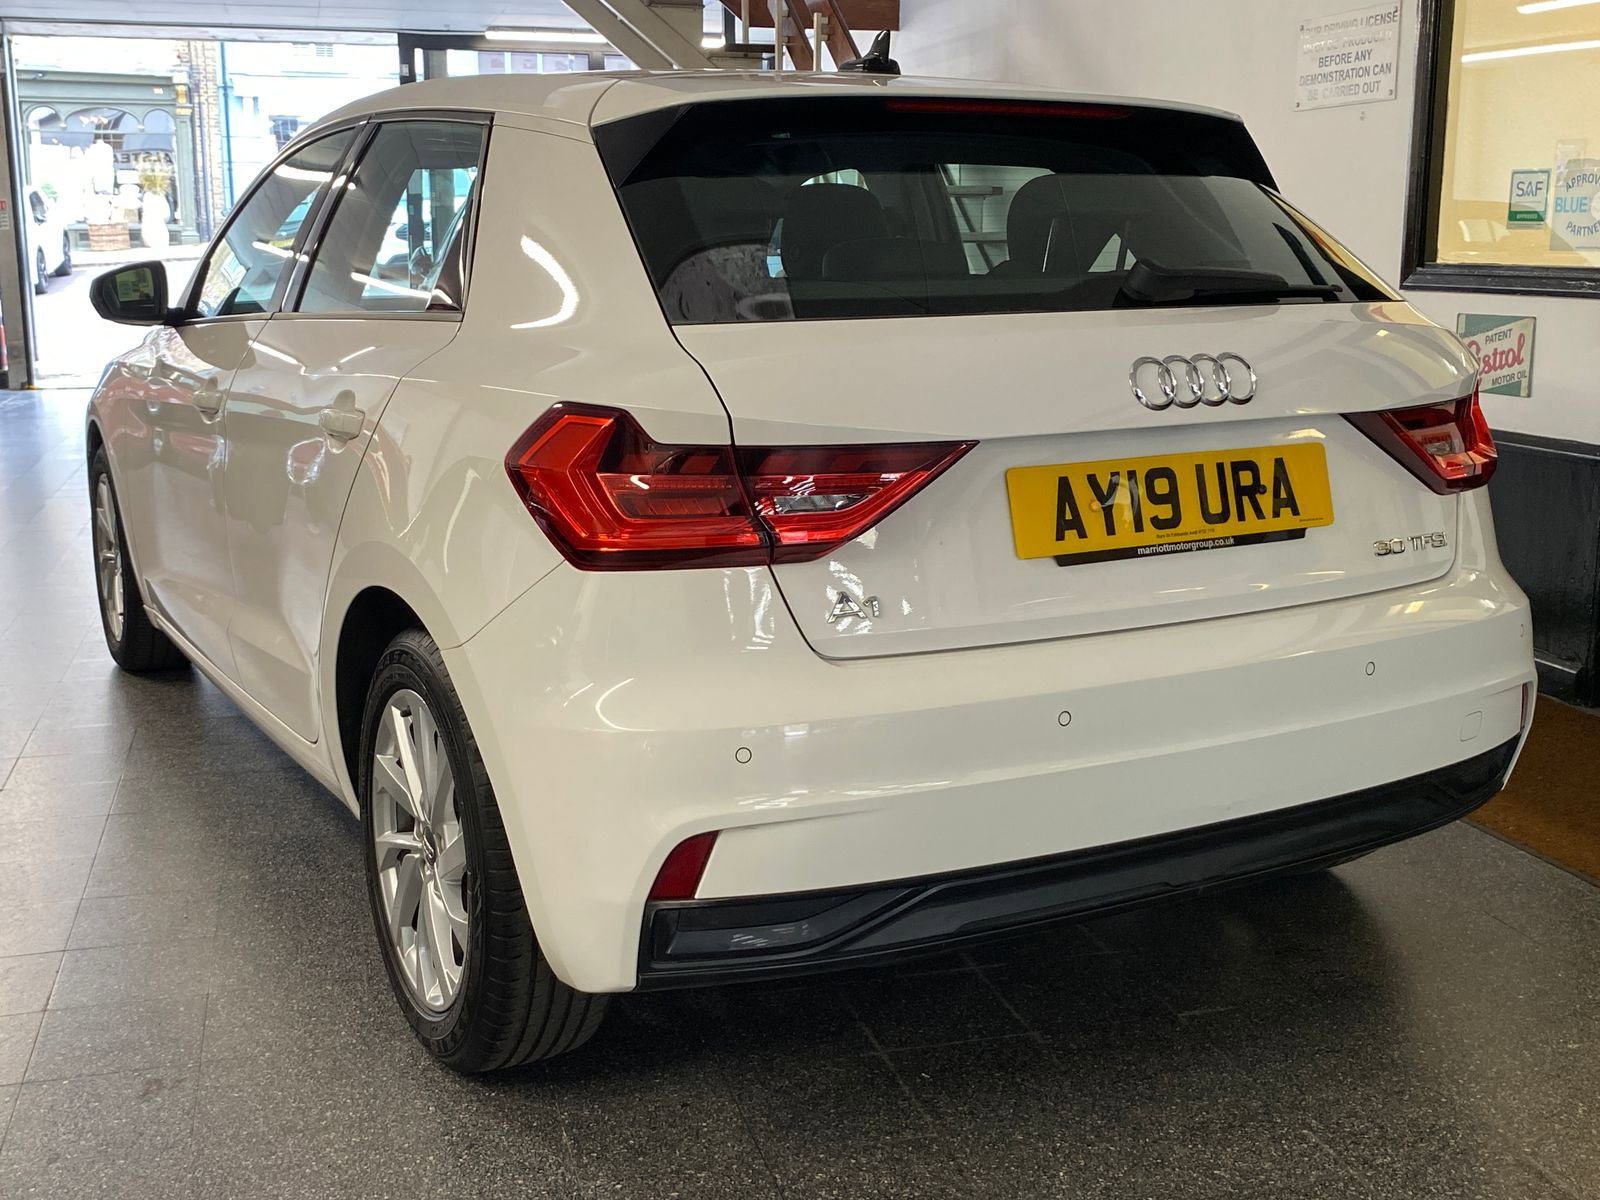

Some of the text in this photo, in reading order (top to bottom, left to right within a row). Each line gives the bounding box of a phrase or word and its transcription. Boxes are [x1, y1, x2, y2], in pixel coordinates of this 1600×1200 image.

[1360, 10, 1398, 27] LICENSE
[1318, 48, 1373, 68] BEFORE ANY
[1299, 62, 1393, 87] DEMONSTRATION CAN
[1322, 84, 1360, 99] CARRIED
[1362, 80, 1382, 94] OUT
[1515, 180, 1544, 197] SAF
[1565, 172, 1600, 193] APPROV
[1554, 196, 1588, 213] BLUE
[1566, 221, 1600, 237] PARTNE
[1485, 328, 1513, 345] PATENT
[1467, 333, 1526, 380] strol
[1491, 369, 1528, 386] MOTOR OIL
[1055, 457, 1301, 542] AY19 URA
[1137, 537, 1235, 555] marriottmotorgroup.co.uk
[1373, 538, 1405, 556] 30
[827, 591, 880, 624] A1
